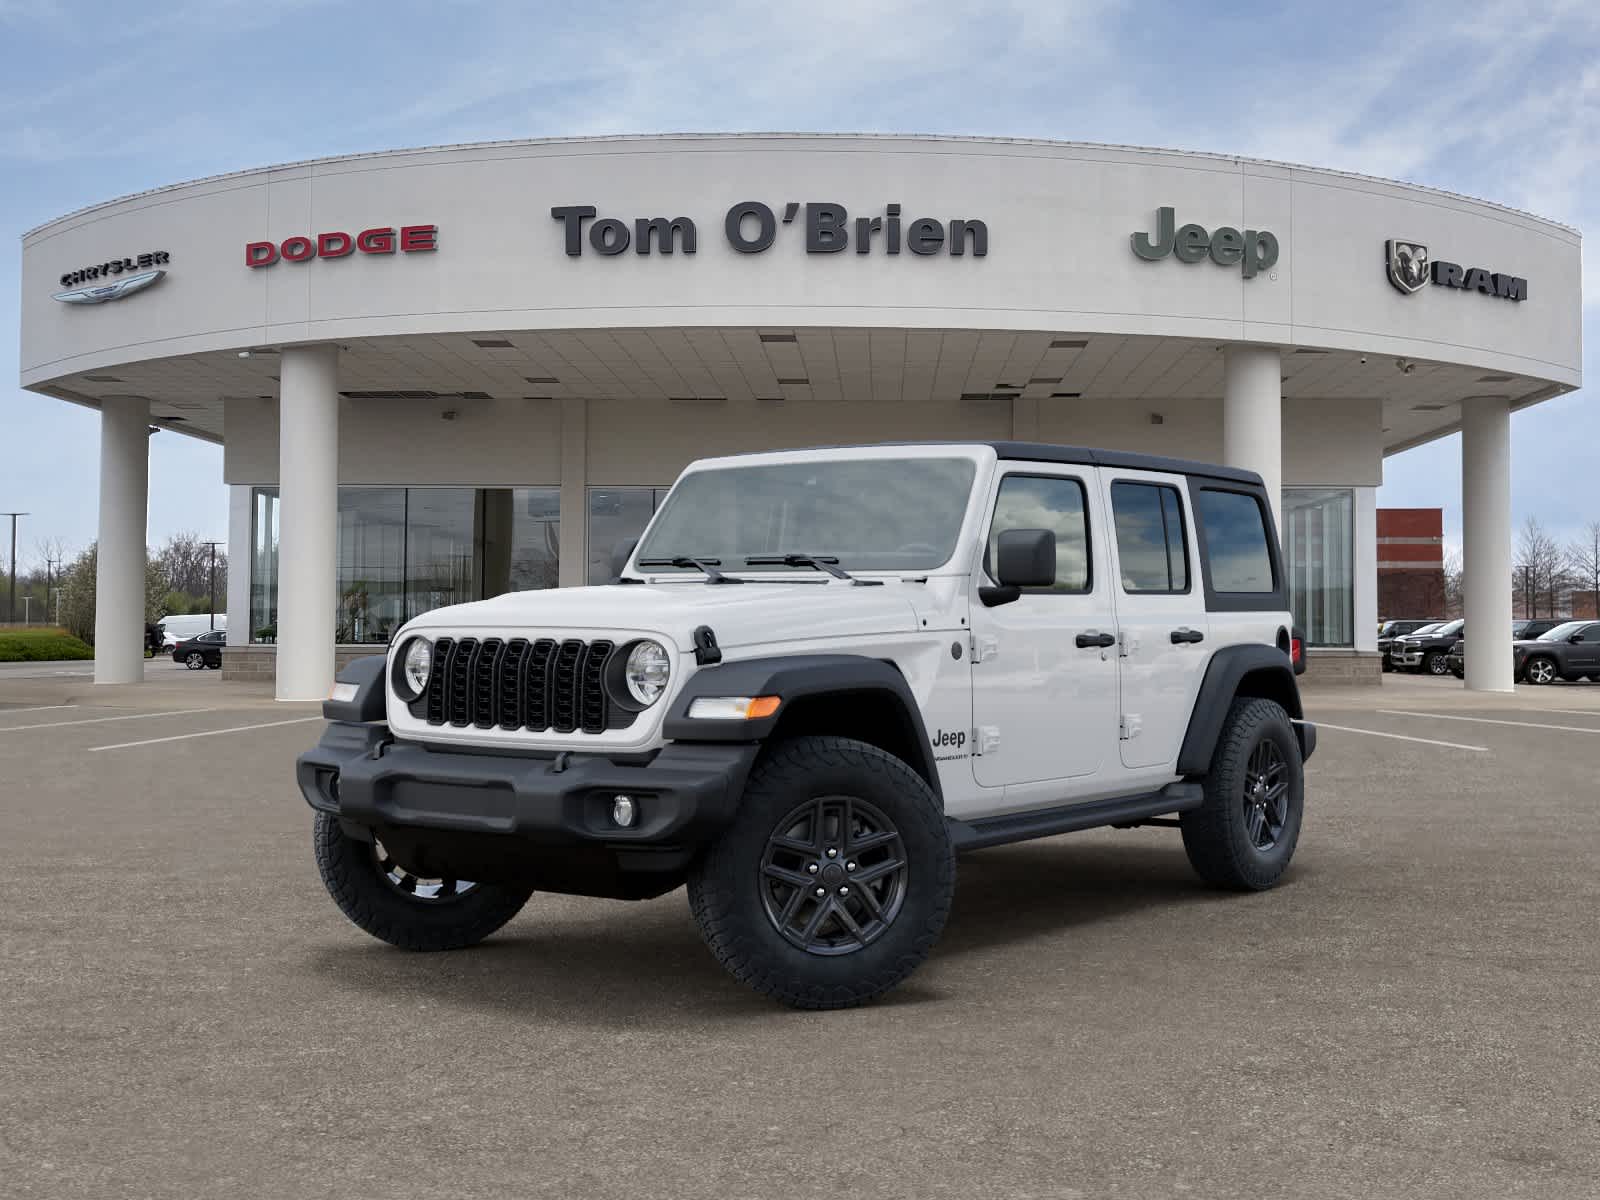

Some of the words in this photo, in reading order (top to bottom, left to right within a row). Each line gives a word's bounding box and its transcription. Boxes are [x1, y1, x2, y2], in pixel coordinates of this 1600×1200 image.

[245, 224, 437, 269] DODGE
[551, 205, 697, 257] Tom
[725, 201, 989, 257] O'Brien
[1130, 206, 1280, 279] Jeep
[60, 250, 170, 287] CHRYSLER
[1431, 261, 1528, 302] RAM
[932, 729, 966, 749] Jeep
